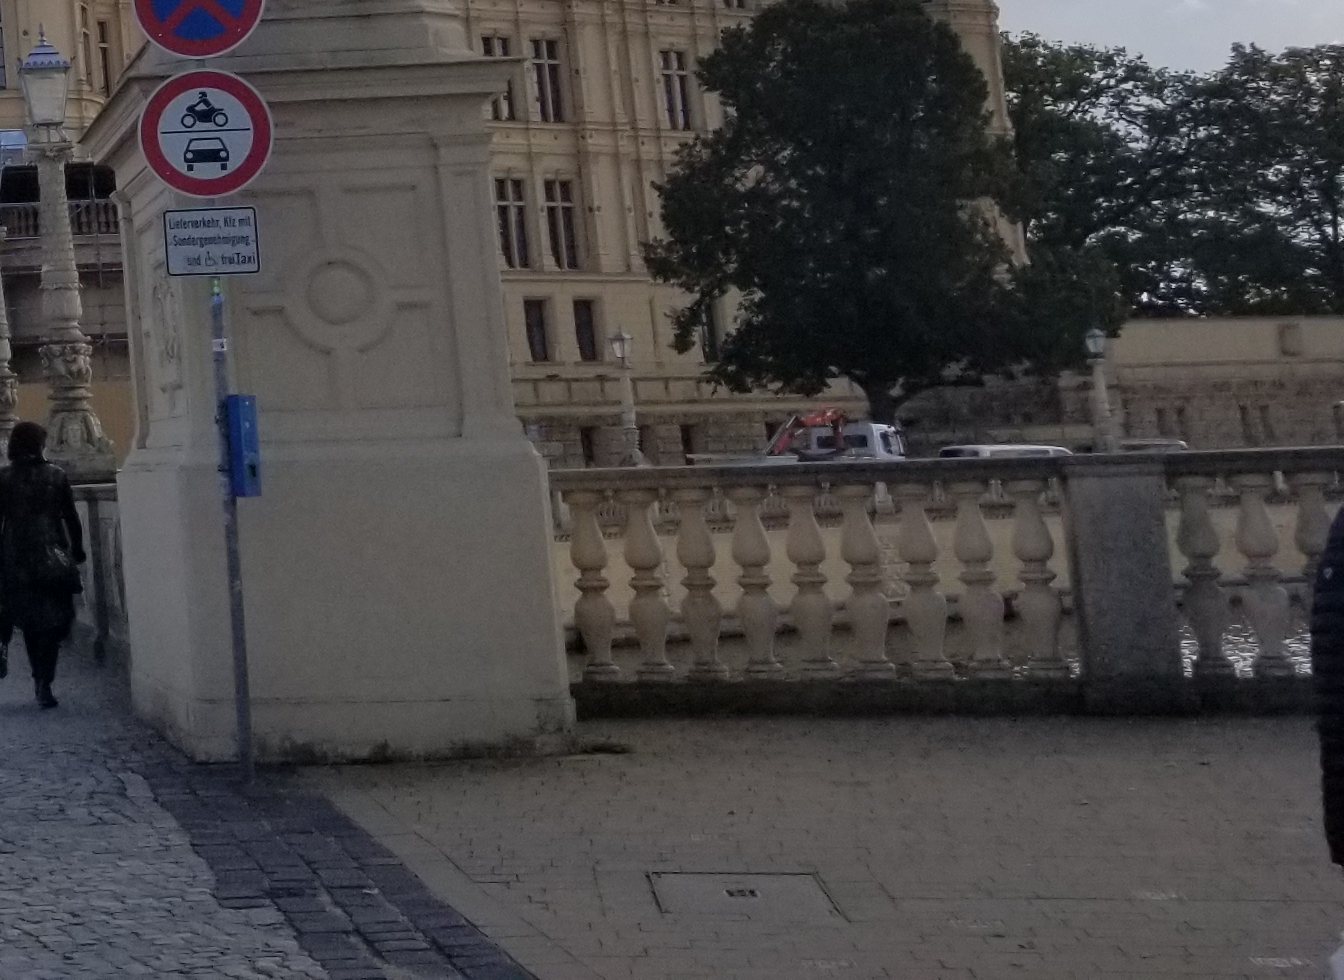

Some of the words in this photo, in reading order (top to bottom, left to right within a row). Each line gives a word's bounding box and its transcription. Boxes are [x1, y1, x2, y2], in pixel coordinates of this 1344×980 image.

[169, 216, 221, 230] Lieferverkehr,
[224, 215, 236, 228] Kfz
[238, 215, 252, 227] mit
[234, 252, 256, 266] Taxi
